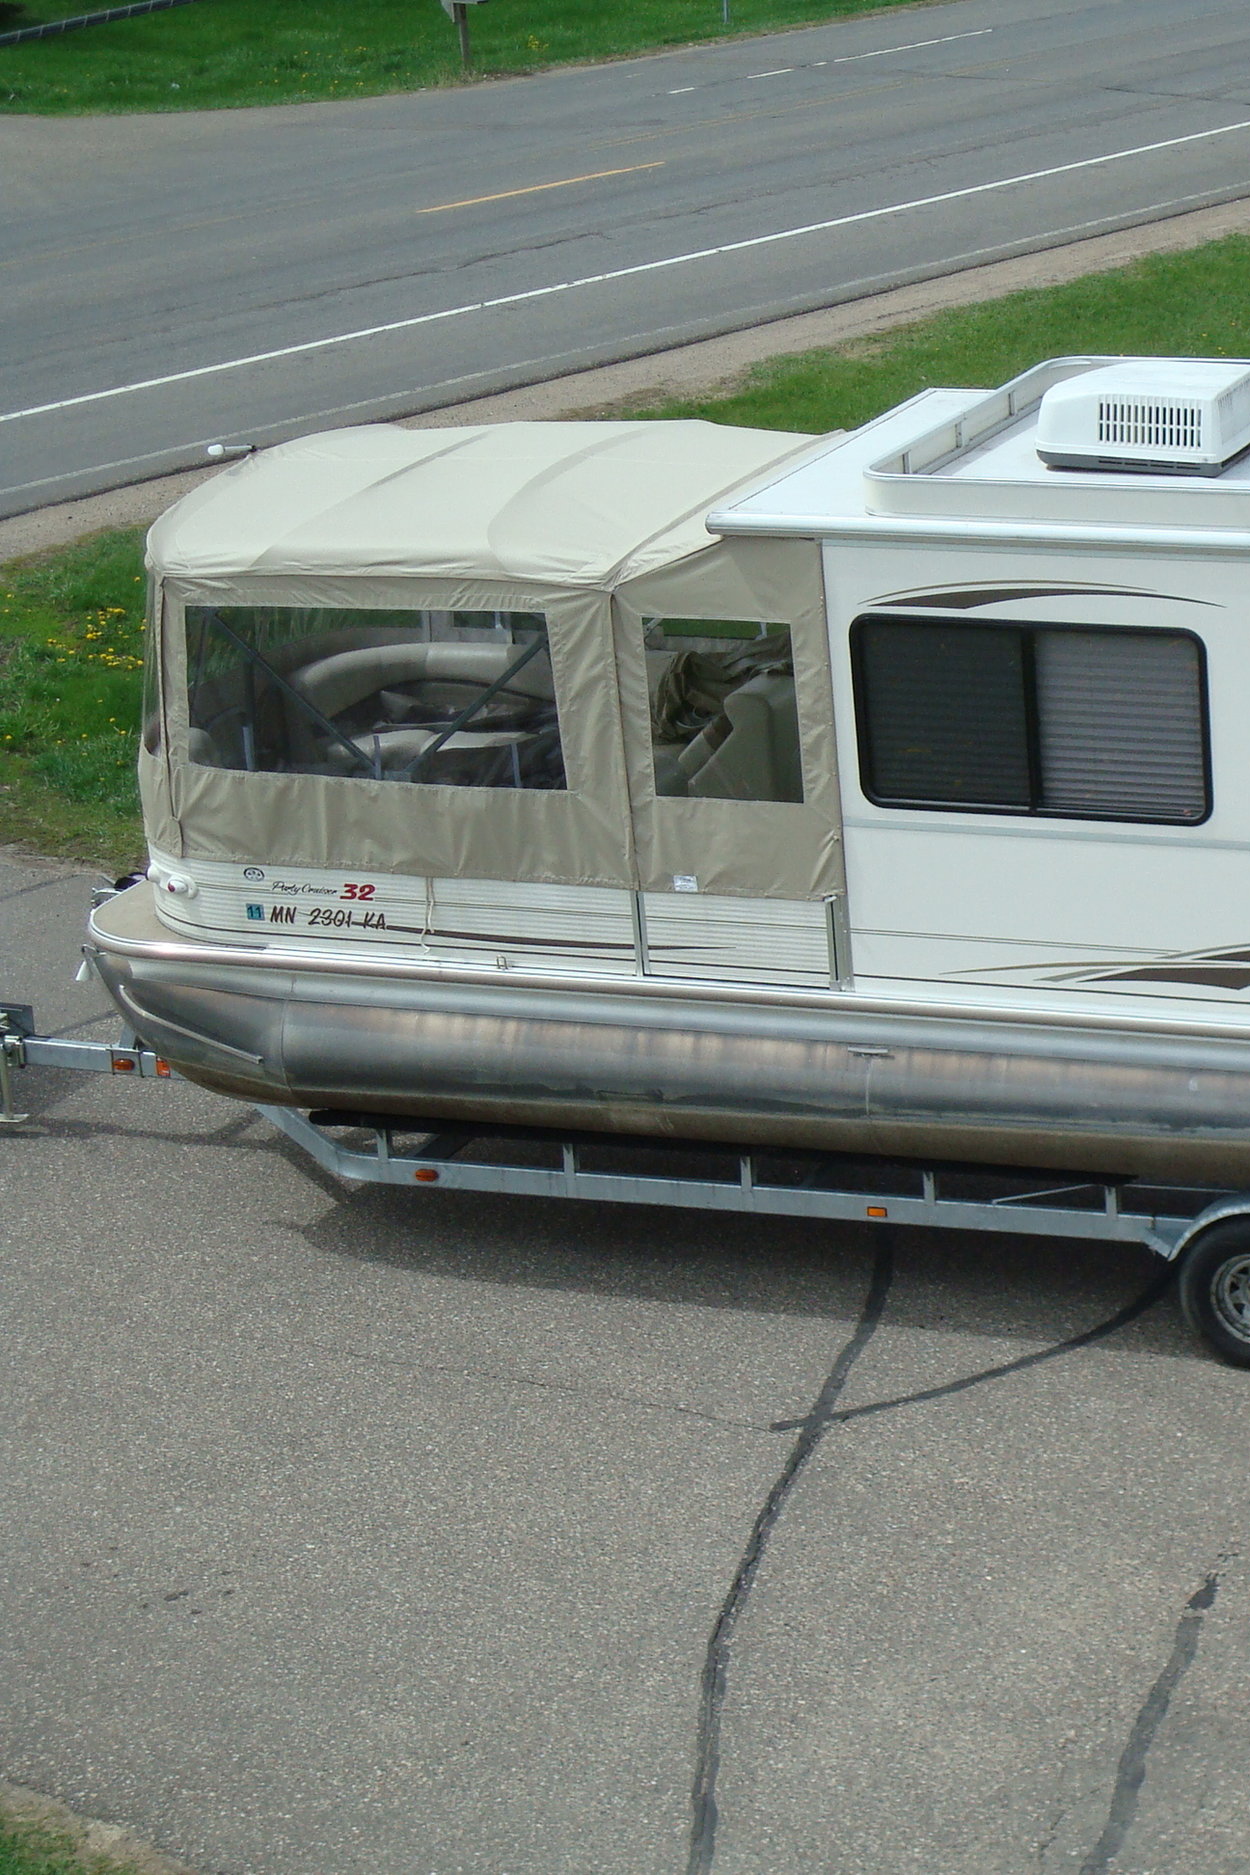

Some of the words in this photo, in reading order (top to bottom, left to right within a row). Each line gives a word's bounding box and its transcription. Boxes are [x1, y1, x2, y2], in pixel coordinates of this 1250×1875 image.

[340, 883, 376, 901] 32
[270, 906, 297, 924] MN
[308, 908, 352, 928] 2301
[363, 911, 386, 930] KA
